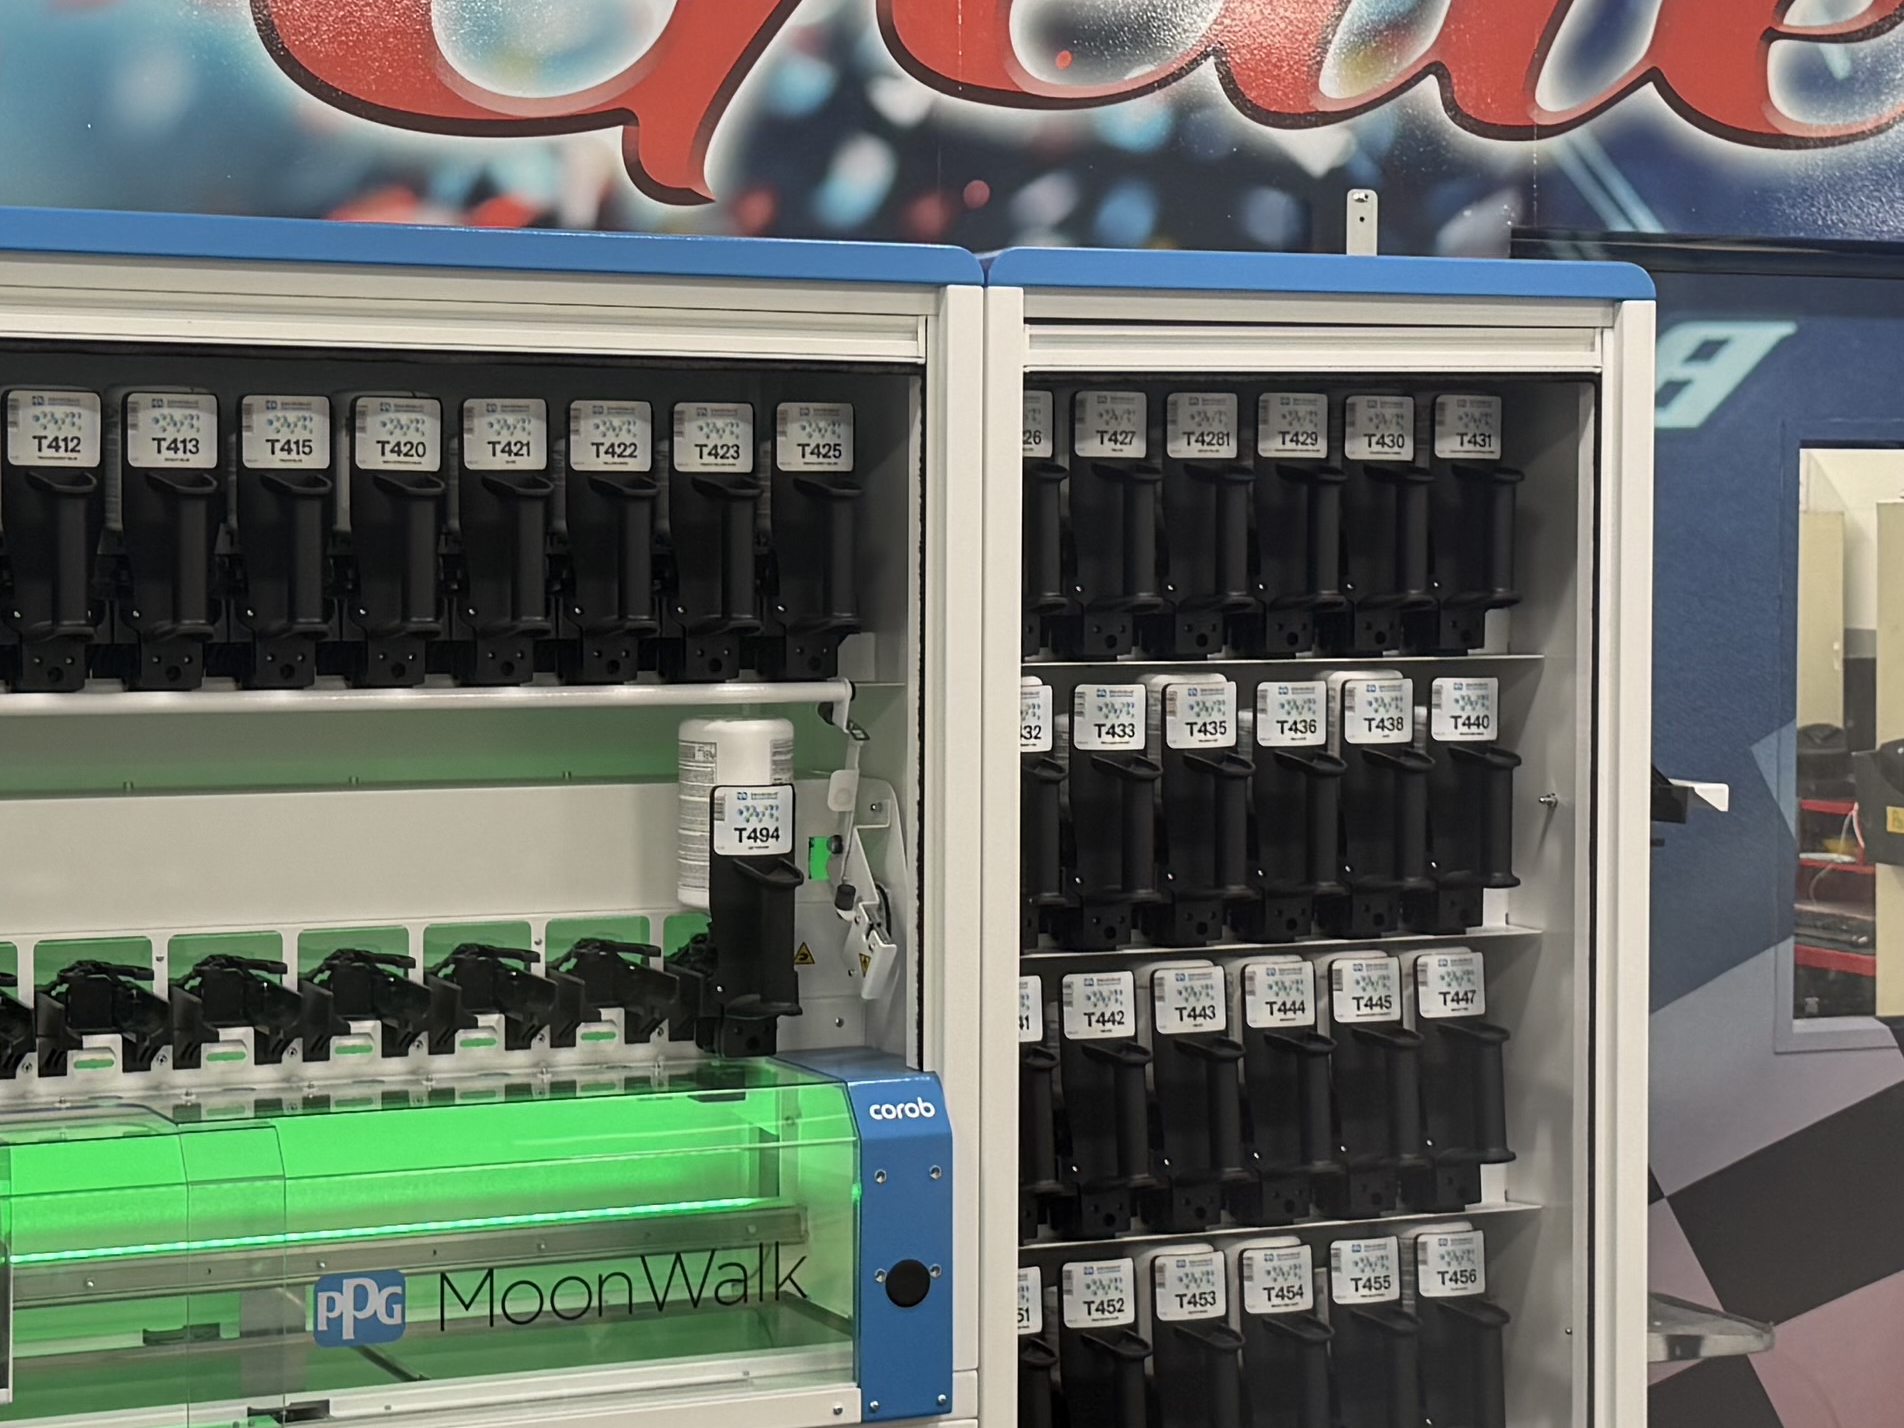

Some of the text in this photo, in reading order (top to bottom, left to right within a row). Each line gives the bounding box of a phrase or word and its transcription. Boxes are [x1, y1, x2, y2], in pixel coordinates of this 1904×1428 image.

[32, 435, 81, 454] T412
[151, 437, 200, 455] T413
[1096, 430, 1136, 446] T427
[1278, 430, 1318, 447] T429
[1363, 433, 1405, 449] T430
[1456, 432, 1492, 448] T431
[266, 438, 313, 456] T415
[376, 440, 426, 458] T420
[487, 440, 531, 458] T421
[590, 441, 638, 459] T422
[694, 443, 740, 460] T423
[796, 443, 842, 460] T425
[1185, 721, 1227, 738] T435
[1275, 719, 1317, 735] T436
[1363, 716, 1404, 734] T438
[1449, 714, 1490, 730] T440
[1093, 723, 1136, 739] T433
[734, 826, 780, 843] T494
[1352, 995, 1392, 1012] T445
[1438, 989, 1476, 1007] T447
[1174, 1004, 1216, 1022] T443
[1265, 1000, 1306, 1017] T444
[1083, 1010, 1125, 1028] T442
[868, 1096, 935, 1121] corob
[1350, 1275, 1392, 1292] T455
[1437, 1269, 1477, 1286] T456
[314, 1240, 809, 1341] PPG MoonWalk
[1262, 1284, 1304, 1302] T454
[1082, 1297, 1125, 1316] T452
[1174, 1290, 1216, 1309] T453
